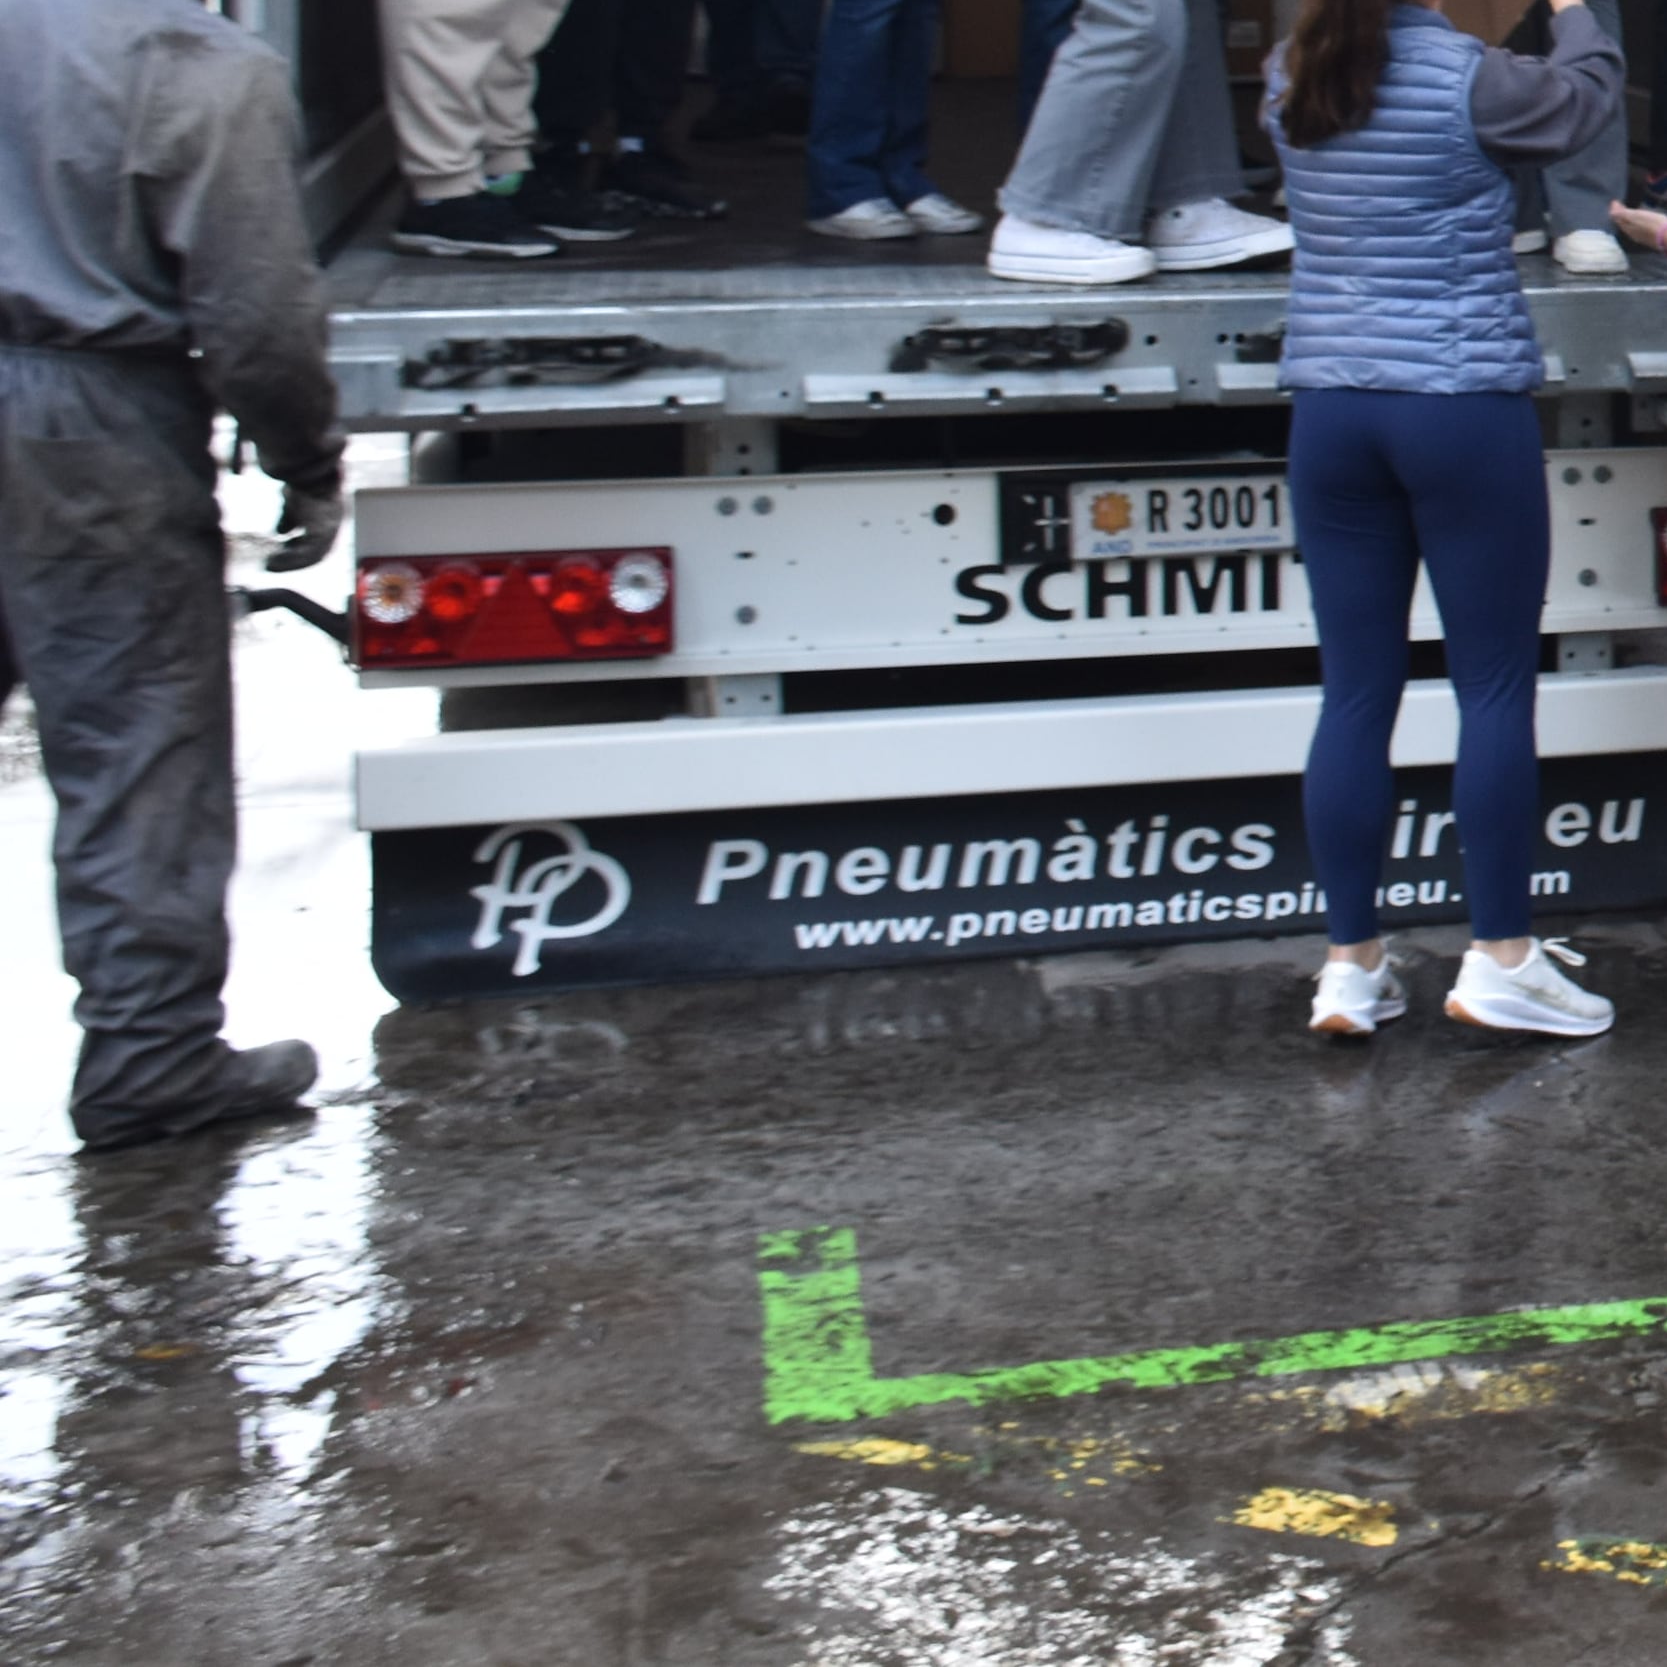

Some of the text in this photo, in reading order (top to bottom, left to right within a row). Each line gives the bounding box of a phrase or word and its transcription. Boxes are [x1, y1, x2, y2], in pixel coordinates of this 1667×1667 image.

[1147, 483, 1280, 533] R 3001
[955, 552, 1304, 625] SCHMI
[696, 798, 1646, 905] Pneumàtics ireu
[795, 865, 1571, 948] www.pneumaticspieu.m
